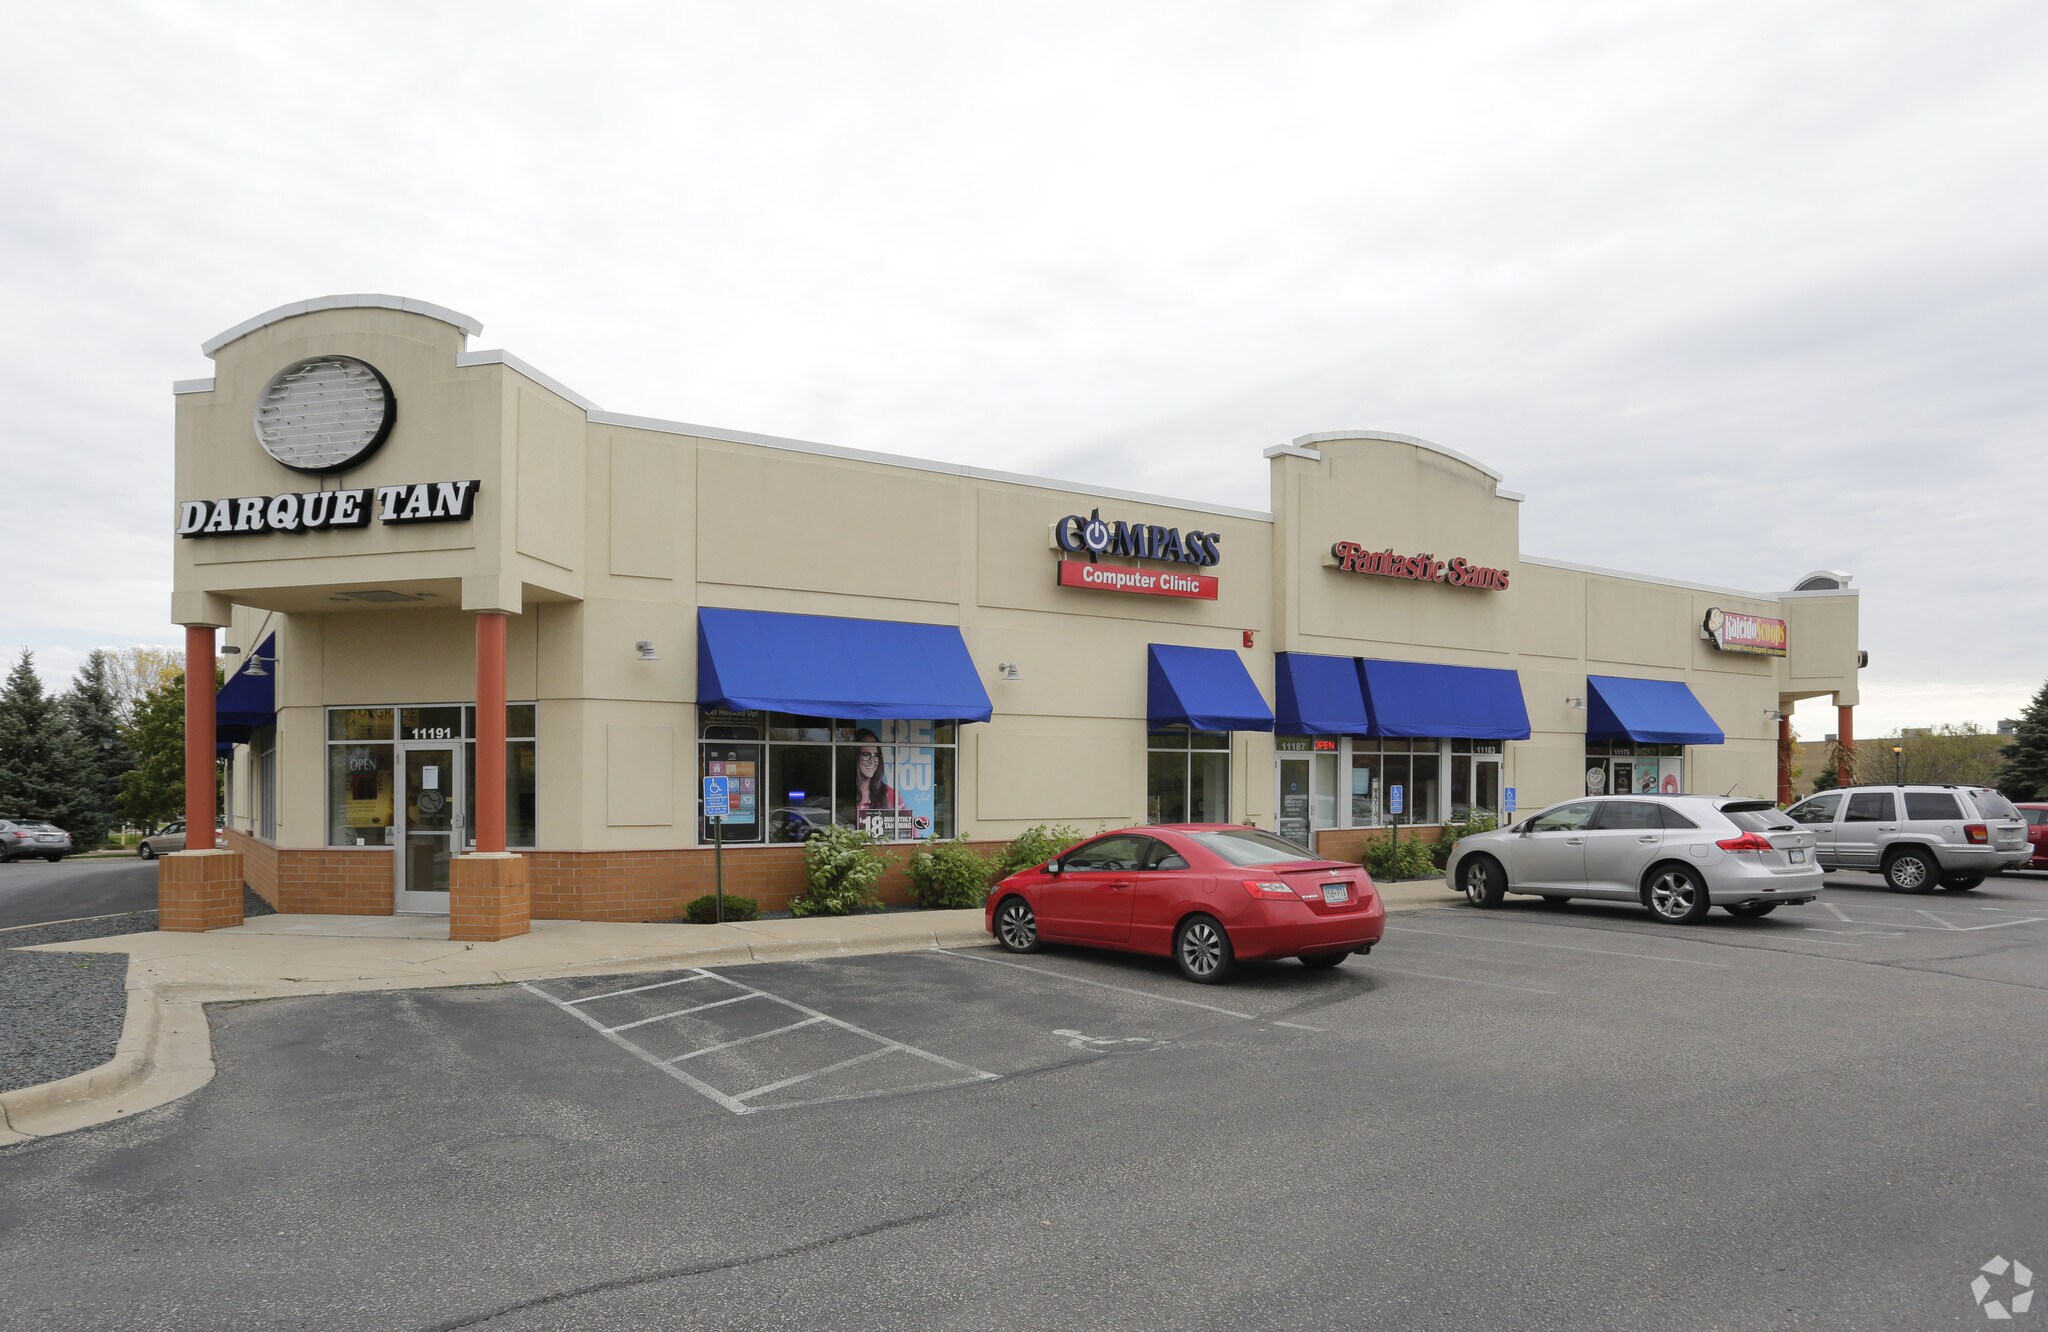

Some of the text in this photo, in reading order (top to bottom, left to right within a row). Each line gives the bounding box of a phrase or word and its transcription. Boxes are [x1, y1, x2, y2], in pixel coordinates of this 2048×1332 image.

[177, 480, 476, 537] DARQUE TAN
[1056, 508, 1221, 567] COMPASS
[1082, 565, 1200, 593] Computer Clinic
[1332, 540, 1510, 591] Fantastic Sams
[1725, 615, 1785, 646] KaleidoScoops
[358, 709, 417, 718] UPGRDE
[412, 727, 451, 740] 11191
[881, 719, 932, 763] BE
[1281, 742, 1306, 751] 11187
[1476, 746, 1495, 754] 11183
[349, 758, 377, 771] OPEN
[881, 764, 932, 791] YOU
[859, 816, 883, 838] $18
